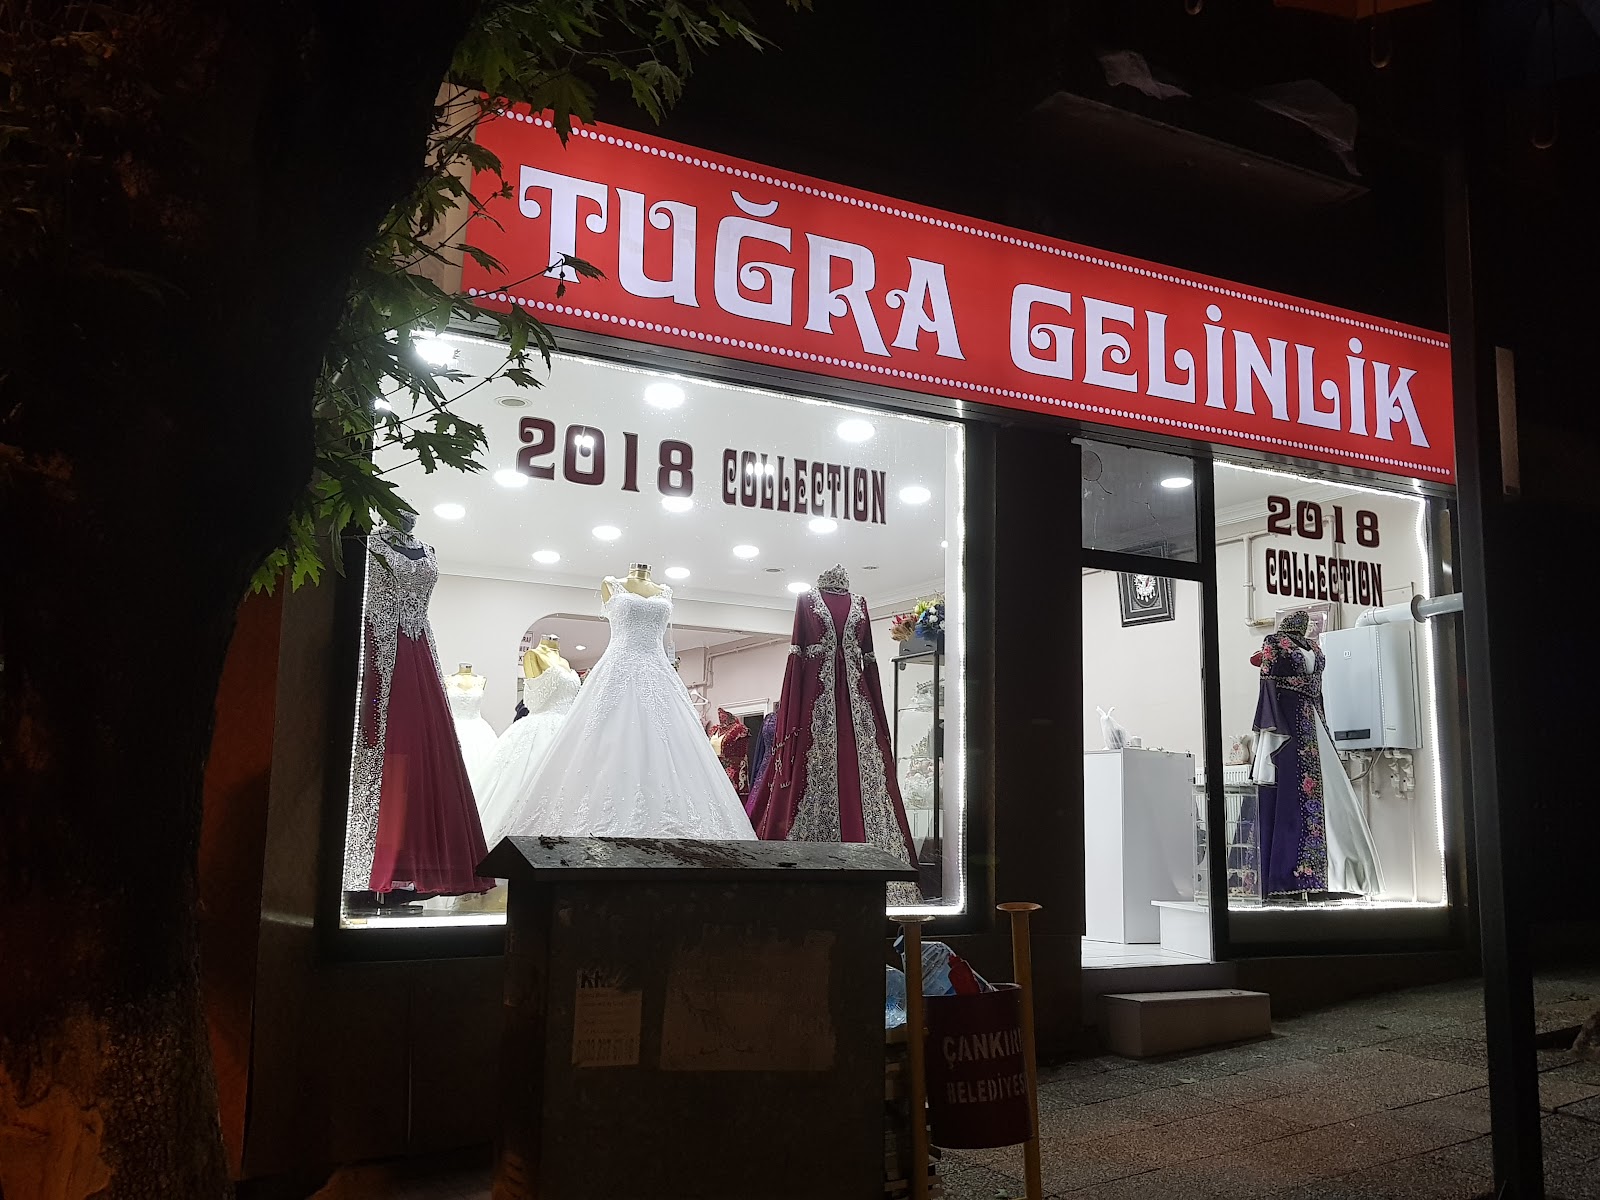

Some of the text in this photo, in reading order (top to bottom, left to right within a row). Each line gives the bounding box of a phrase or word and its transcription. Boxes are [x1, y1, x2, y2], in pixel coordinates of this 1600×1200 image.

[518, 164, 1431, 448] TUĞRA GELİNLİK
[515, 415, 887, 525] 2018 COLLECTION
[1267, 494, 1380, 548] 2018
[1265, 547, 1384, 608] COLLECTION
